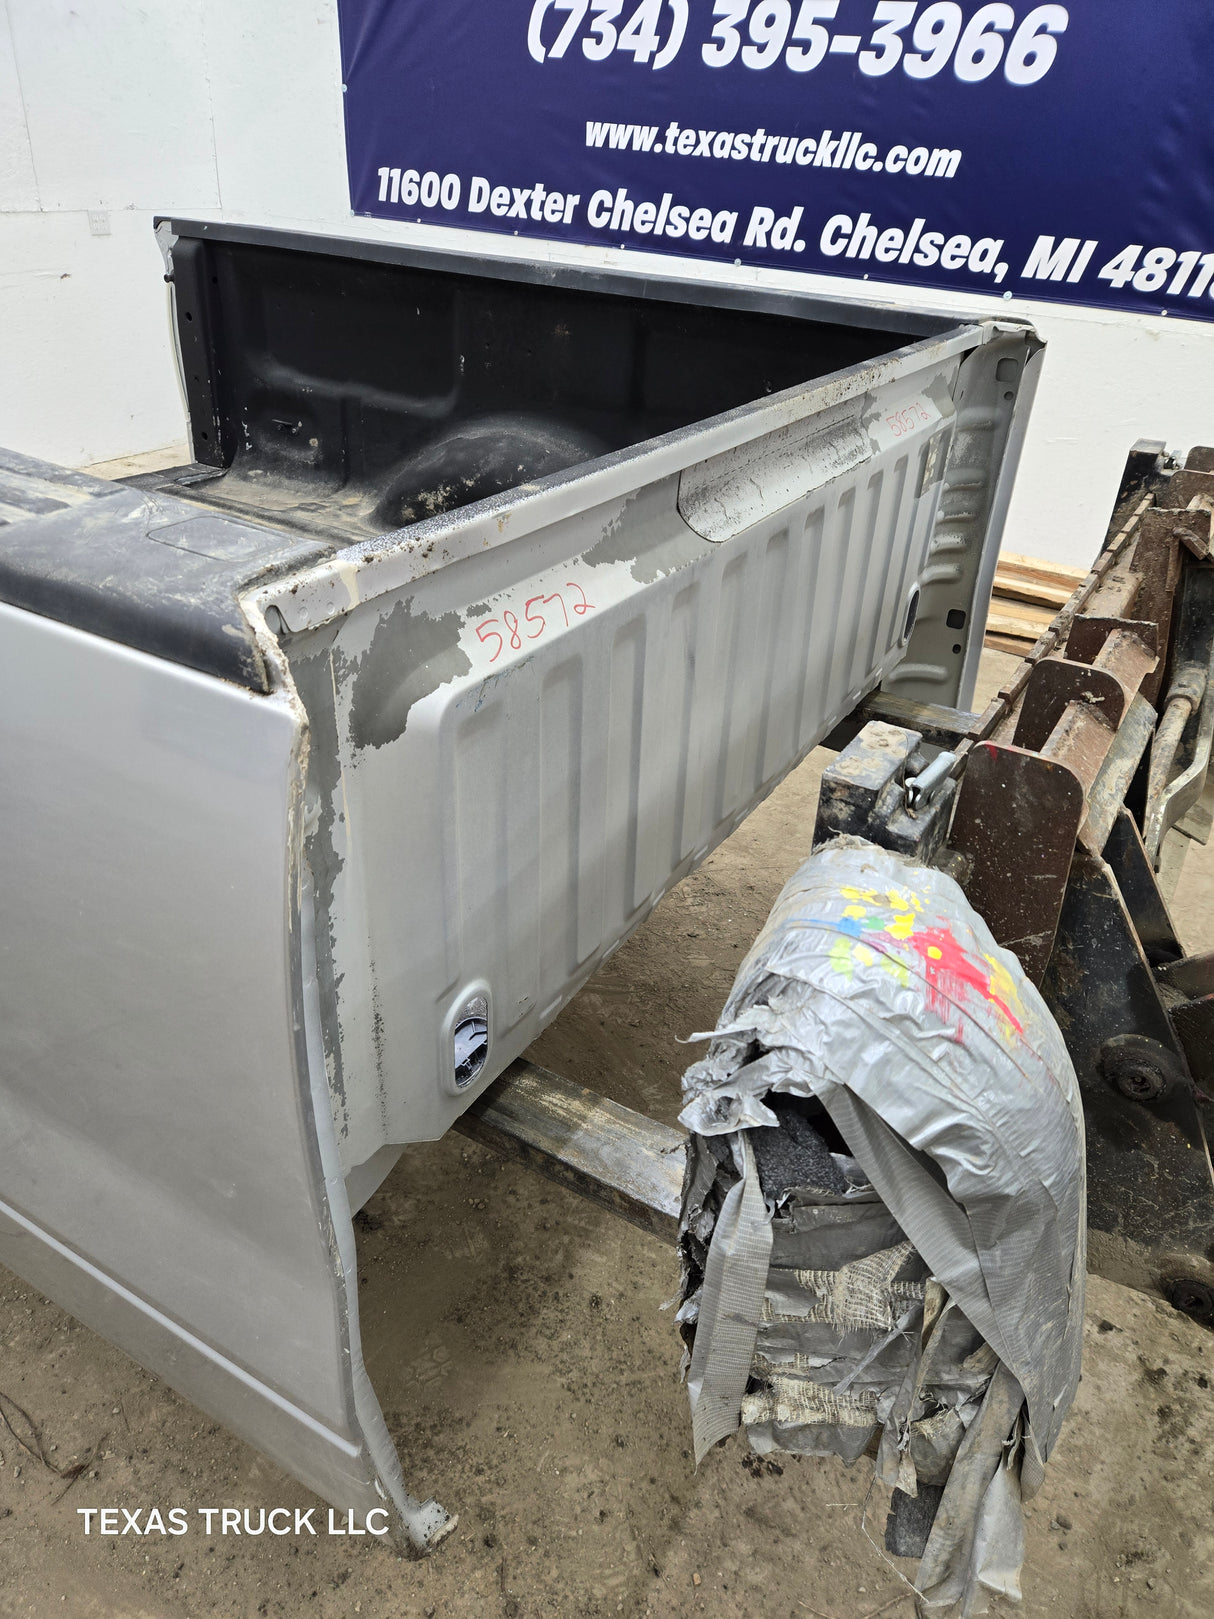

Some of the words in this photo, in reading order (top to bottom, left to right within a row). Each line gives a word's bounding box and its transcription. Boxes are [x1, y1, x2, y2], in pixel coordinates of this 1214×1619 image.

[527, 0, 689, 71] (734)
[701, 0, 1069, 86] 395-3966
[585, 121, 962, 179] www.texastruckllc.com
[377, 166, 461, 211] 11600
[467, 176, 581, 225] Dexter
[587, 187, 740, 245] Chelsea
[742, 206, 807, 253] Rd.
[819, 212, 1010, 284] Chelsea,
[1020, 235, 1099, 284] MI
[1097, 244, 1214, 300] 4811
[475, 582, 596, 663] 58572
